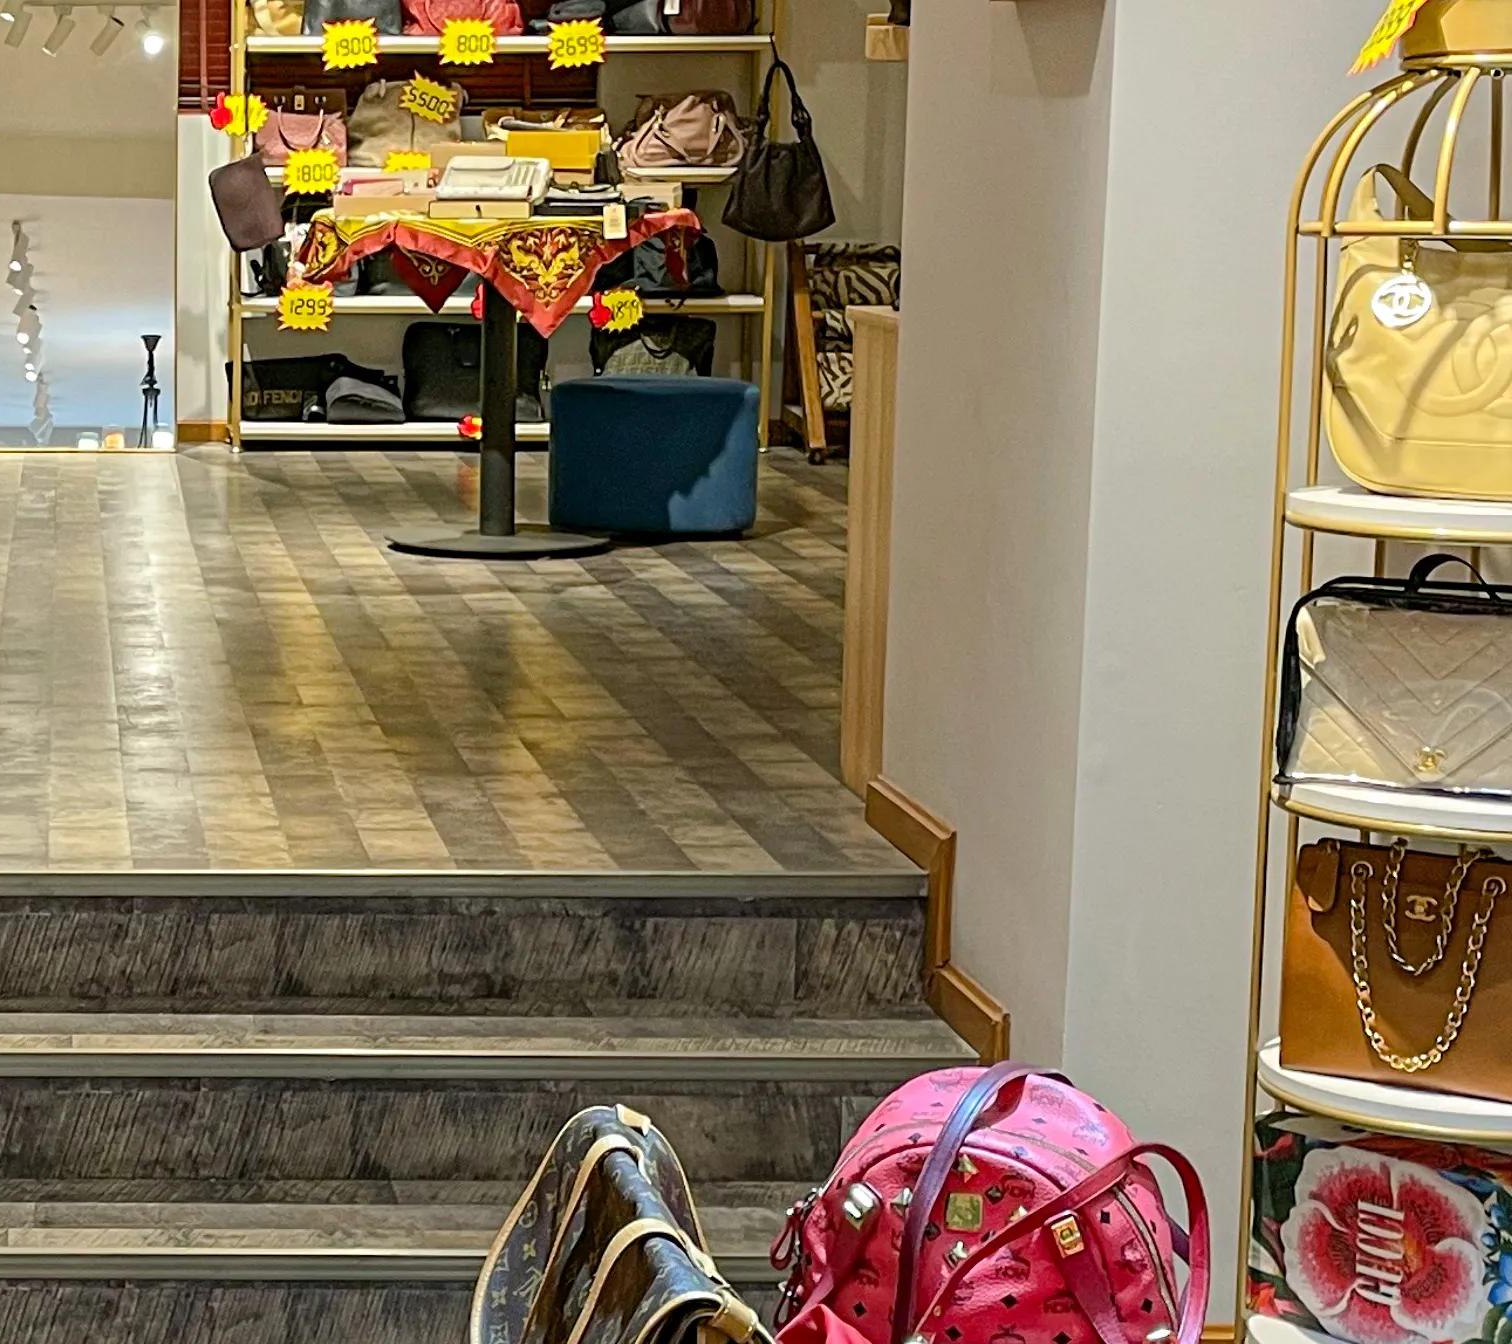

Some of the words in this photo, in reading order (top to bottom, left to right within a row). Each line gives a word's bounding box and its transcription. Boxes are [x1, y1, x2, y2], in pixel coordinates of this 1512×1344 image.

[335, 35, 373, 57] 1900
[456, 34, 490, 54] 800
[554, 35, 600, 57] 2699
[408, 86, 449, 117] 5500
[297, 163, 334, 183] 1800
[289, 298, 327, 316] 1299
[1355, 1199, 1405, 1308] GUCCI
